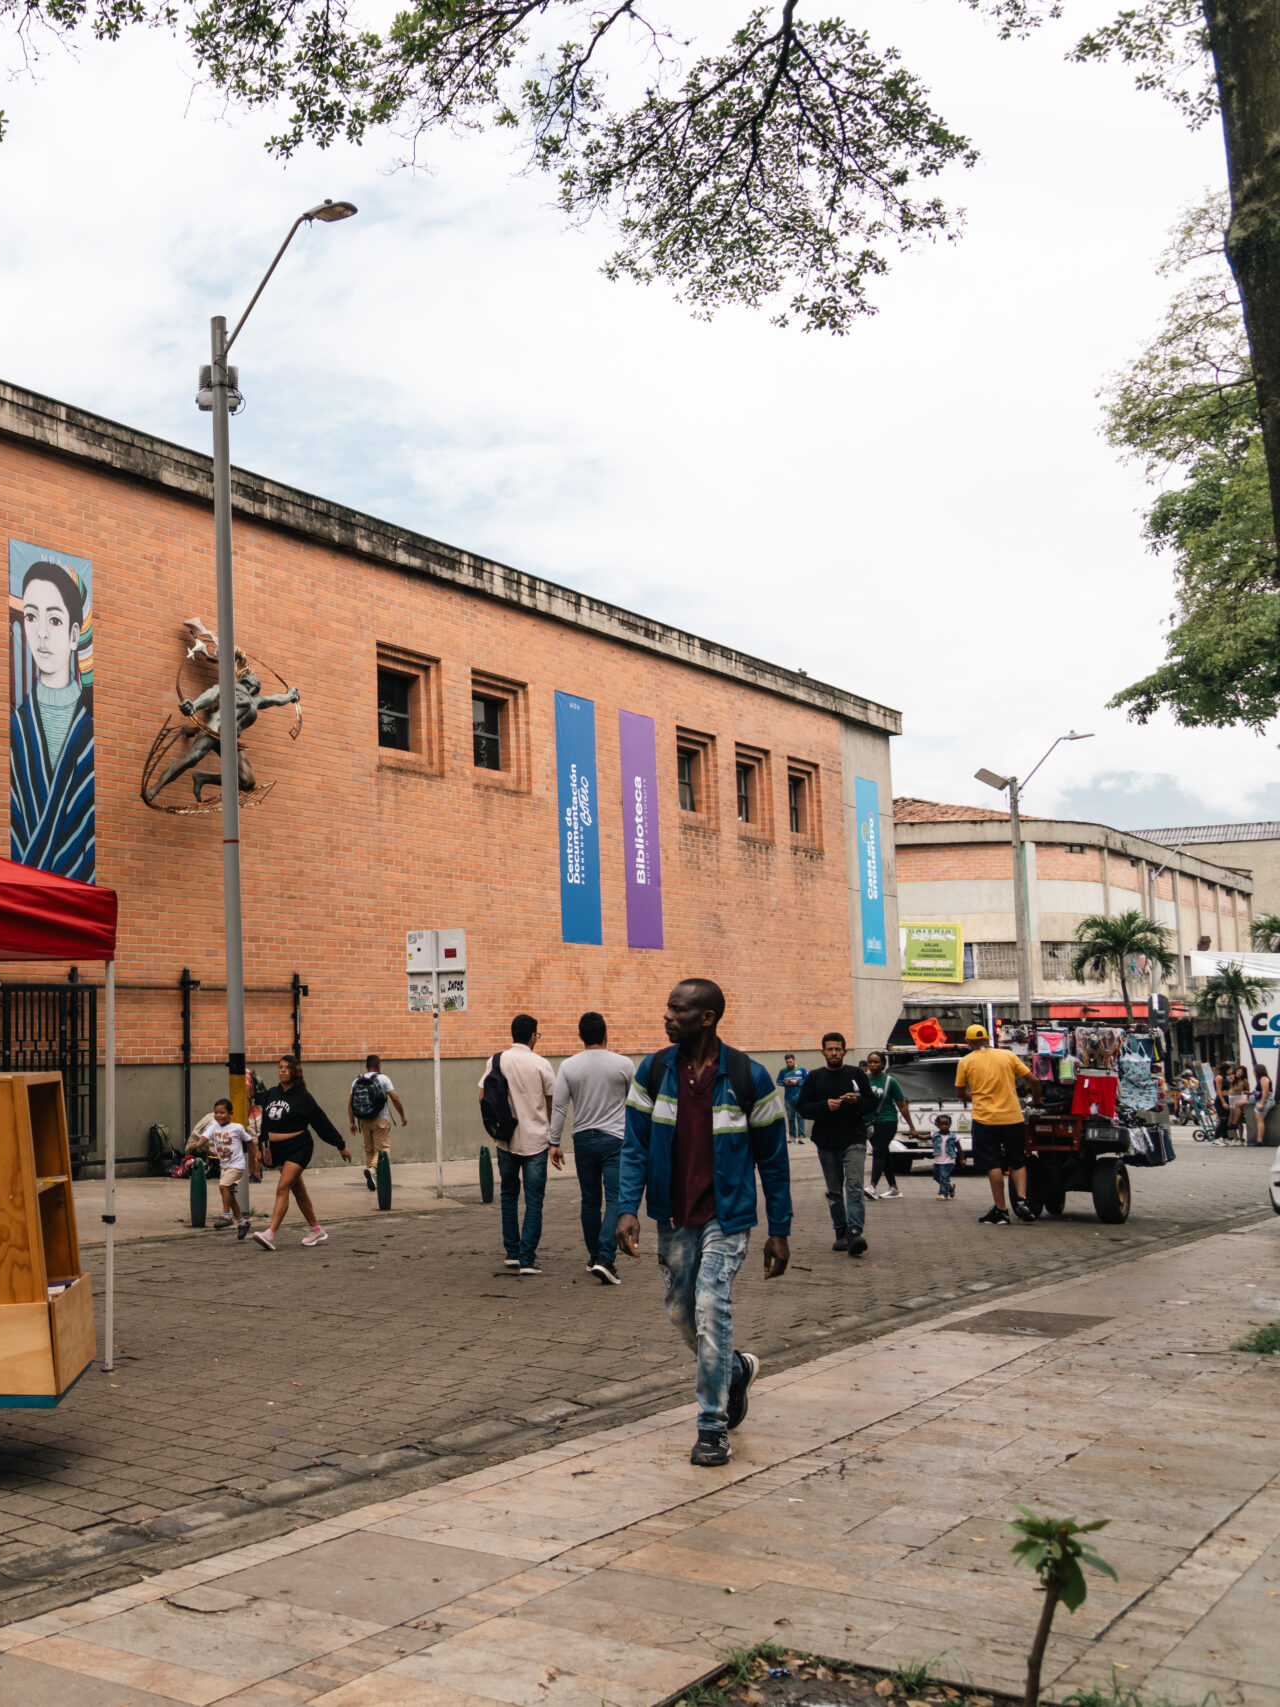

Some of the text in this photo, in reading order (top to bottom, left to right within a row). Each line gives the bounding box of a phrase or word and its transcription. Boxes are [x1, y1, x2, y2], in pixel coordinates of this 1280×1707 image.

[565, 807, 572, 827] de
[570, 763, 581, 885] Documentación
[634, 776, 646, 885] Biblioteca
[268, 1106, 283, 1120] 94
